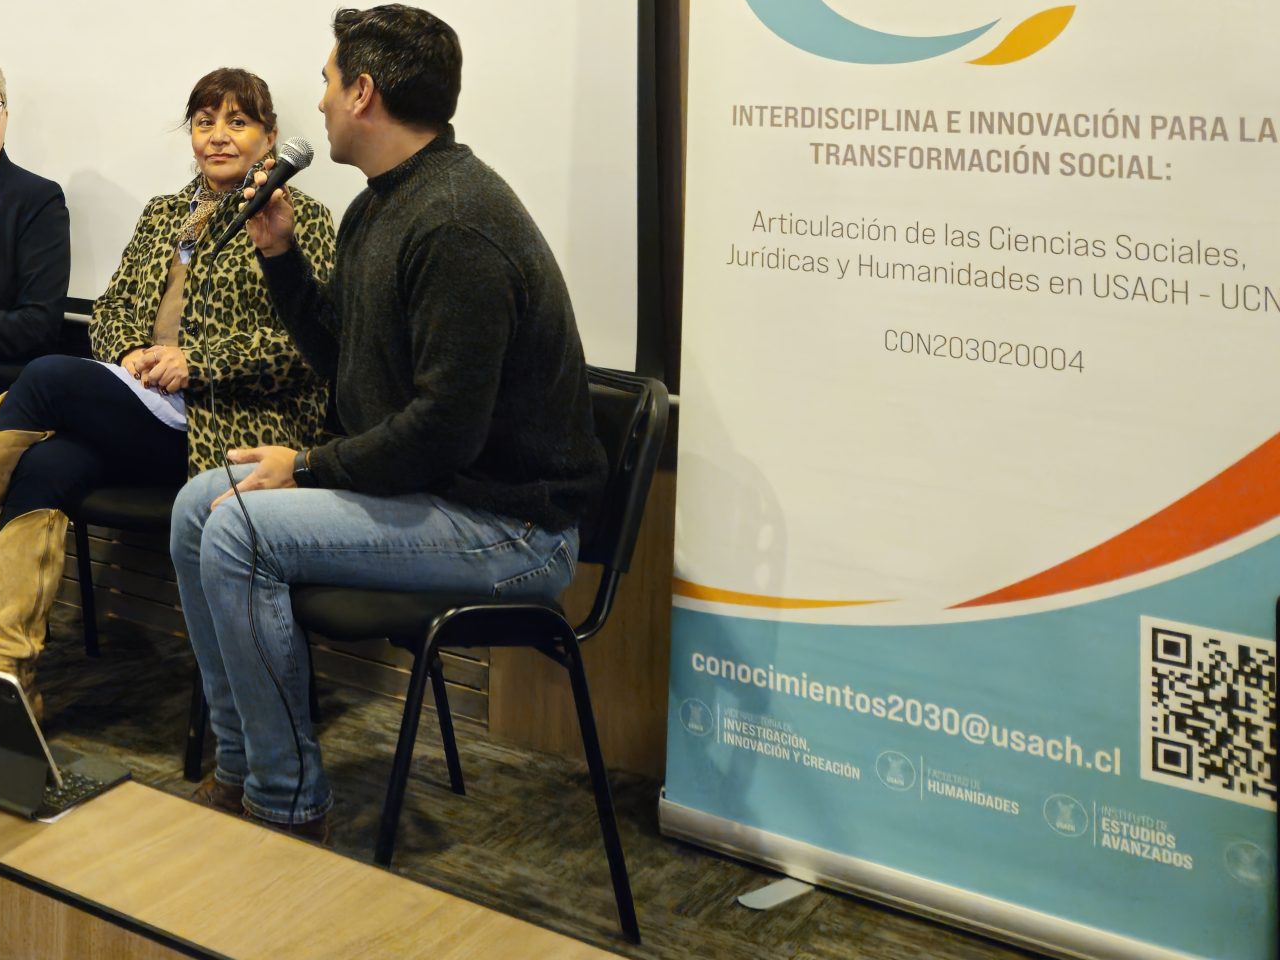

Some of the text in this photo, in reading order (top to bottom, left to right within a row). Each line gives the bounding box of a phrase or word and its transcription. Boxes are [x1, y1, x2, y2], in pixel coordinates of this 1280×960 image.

[732, 105, 1279, 143] INTERDISCIPLINA E INNOVACIÓN PARA LA
[810, 143, 1172, 181] TRANSFORMACIÓN SOCIAL:
[752, 210, 1246, 270] Articulación de las Ciencias Sociales,
[726, 243, 830, 274] Jurídicas
[836, 258, 850, 279] y
[858, 254, 1040, 292] Humanidades
[1049, 276, 1082, 296] en
[1093, 273, 1189, 305] USACH
[1221, 282, 1280, 313] UCN
[884, 329, 1085, 374] CON203020004
[691, 651, 1122, 776] conocimientos2030@usach.cl
[723, 718, 811, 752] INVESTIGACIÓN,
[723, 732, 861, 780] INNOVACIÓN Y CREACIÓN
[927, 779, 1020, 815] HUMANIDADES
[1102, 817, 1176, 849] ESTUDIOS
[1102, 834, 1193, 870] AVANZADOS
